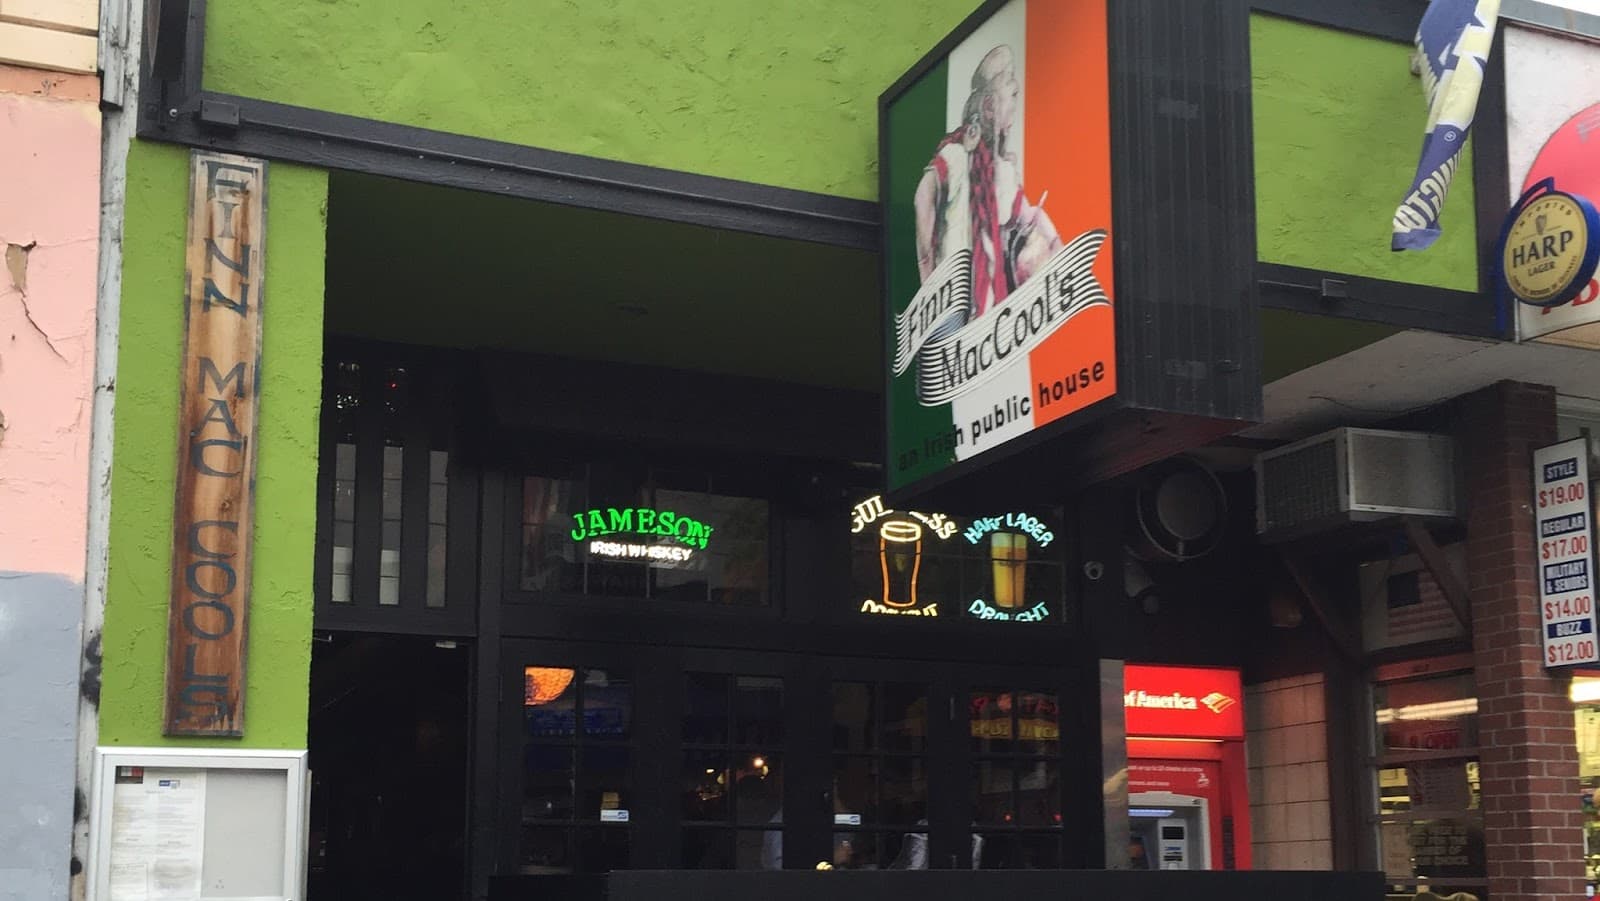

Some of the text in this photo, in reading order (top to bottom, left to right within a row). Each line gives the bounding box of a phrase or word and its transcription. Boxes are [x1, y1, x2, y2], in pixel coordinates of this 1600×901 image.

[202, 160, 259, 318] FINN
[1511, 230, 1574, 268] HARP
[1527, 261, 1556, 276] LAGER
[905, 278, 953, 351] Finn
[940, 269, 1076, 392] MacCool's
[972, 395, 1031, 445] public
[1039, 361, 1105, 408] house
[190, 356, 248, 478] MAC
[1546, 461, 1576, 480] STYLE
[1539, 482, 1584, 508] $19.00
[571, 508, 714, 549] JAMESON
[1542, 514, 1585, 535] REGULAR
[590, 541, 692, 560] IRISH WHISKEY
[1541, 535, 1587, 559] $17.00
[968, 599, 1050, 622] DRAGHT
[1545, 596, 1590, 620] $14.00
[1556, 621, 1583, 636] BUZZ
[1548, 640, 1593, 663] $12.00
[1137, 691, 1198, 709] America
